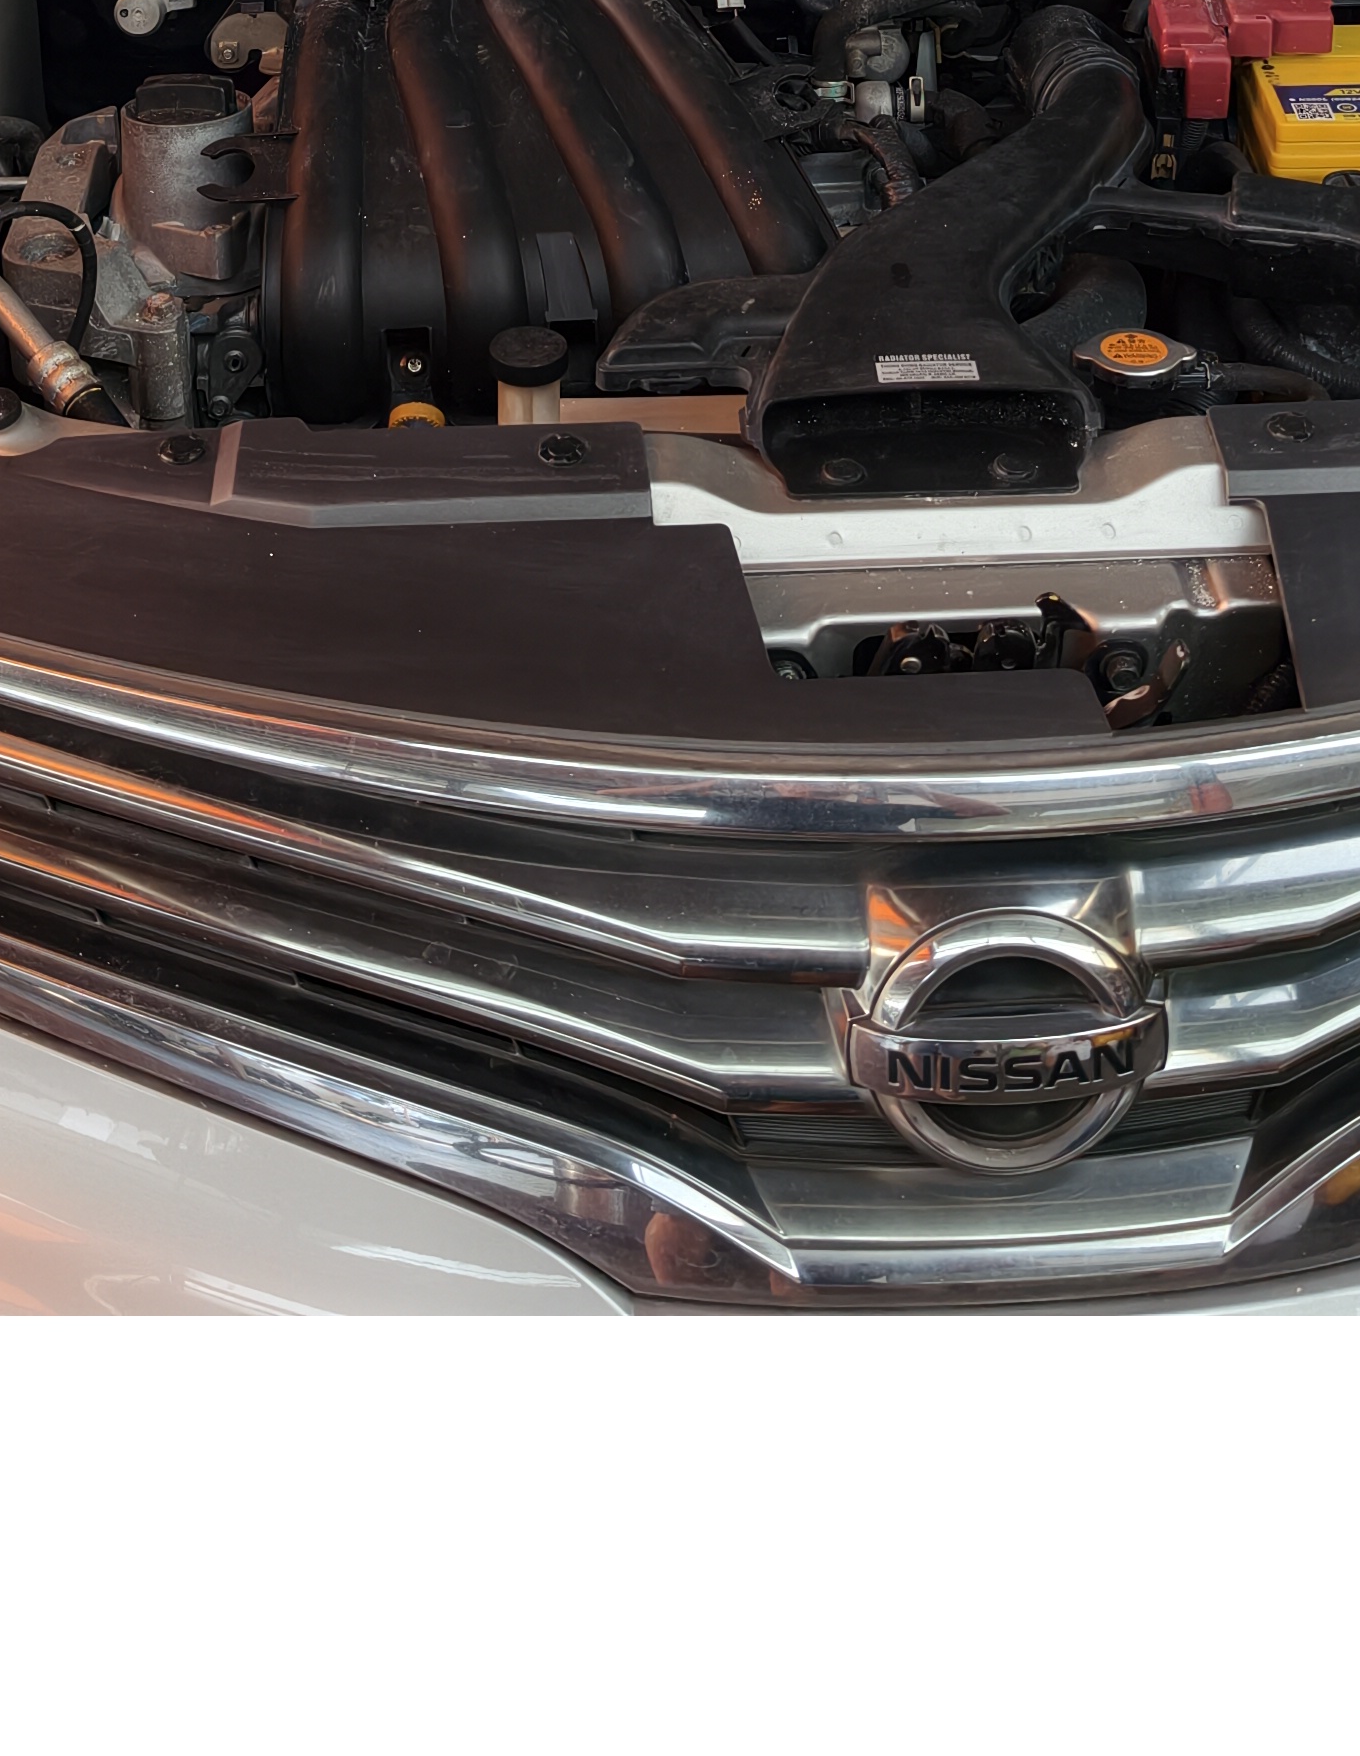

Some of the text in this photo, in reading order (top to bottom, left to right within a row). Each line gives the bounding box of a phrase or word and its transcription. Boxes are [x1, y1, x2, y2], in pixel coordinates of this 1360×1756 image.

[878, 353, 970, 362] RADIATOR SPECIALIST
[887, 1044, 1135, 1093] NISSAN
